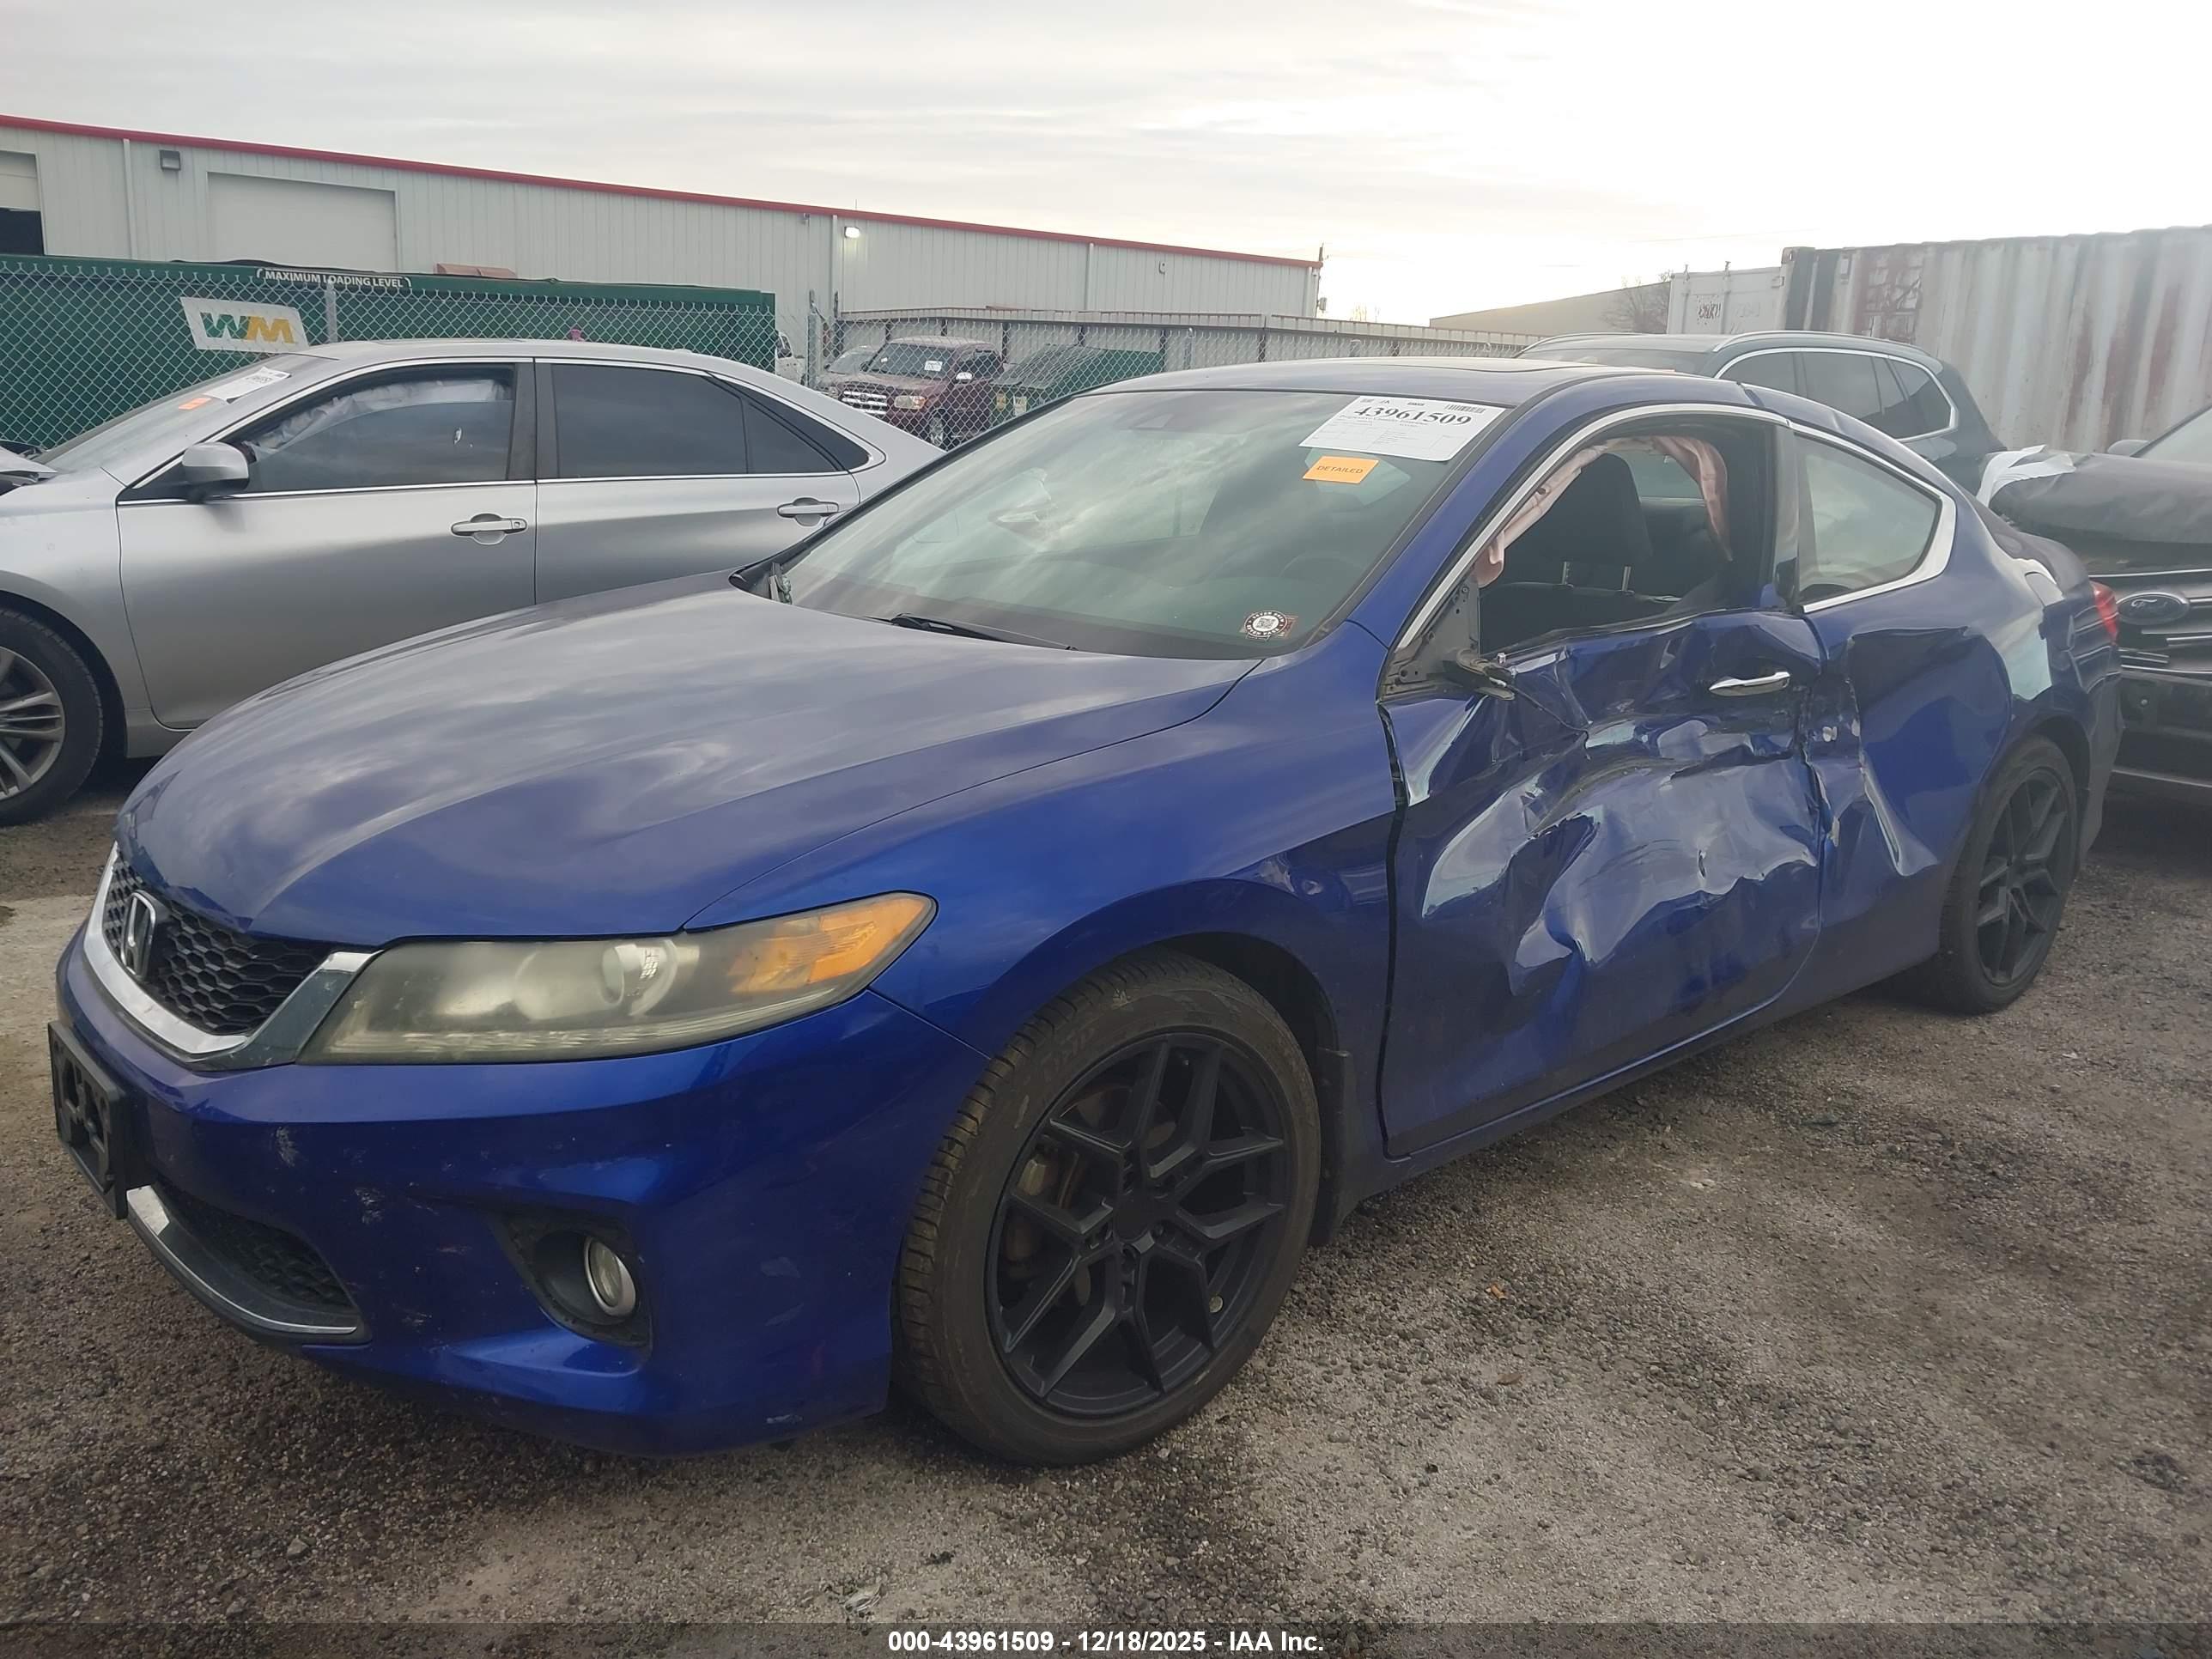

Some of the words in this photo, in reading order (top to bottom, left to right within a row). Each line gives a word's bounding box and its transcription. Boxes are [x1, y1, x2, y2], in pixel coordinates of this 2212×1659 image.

[264, 270, 321, 283] MAXIMUM
[323, 275, 371, 287] LOADING
[372, 277, 404, 288] LEVEL
[199, 312, 295, 344] WM
[1353, 405, 1473, 427] 43961509
[1316, 465, 1364, 475] DETAILED
